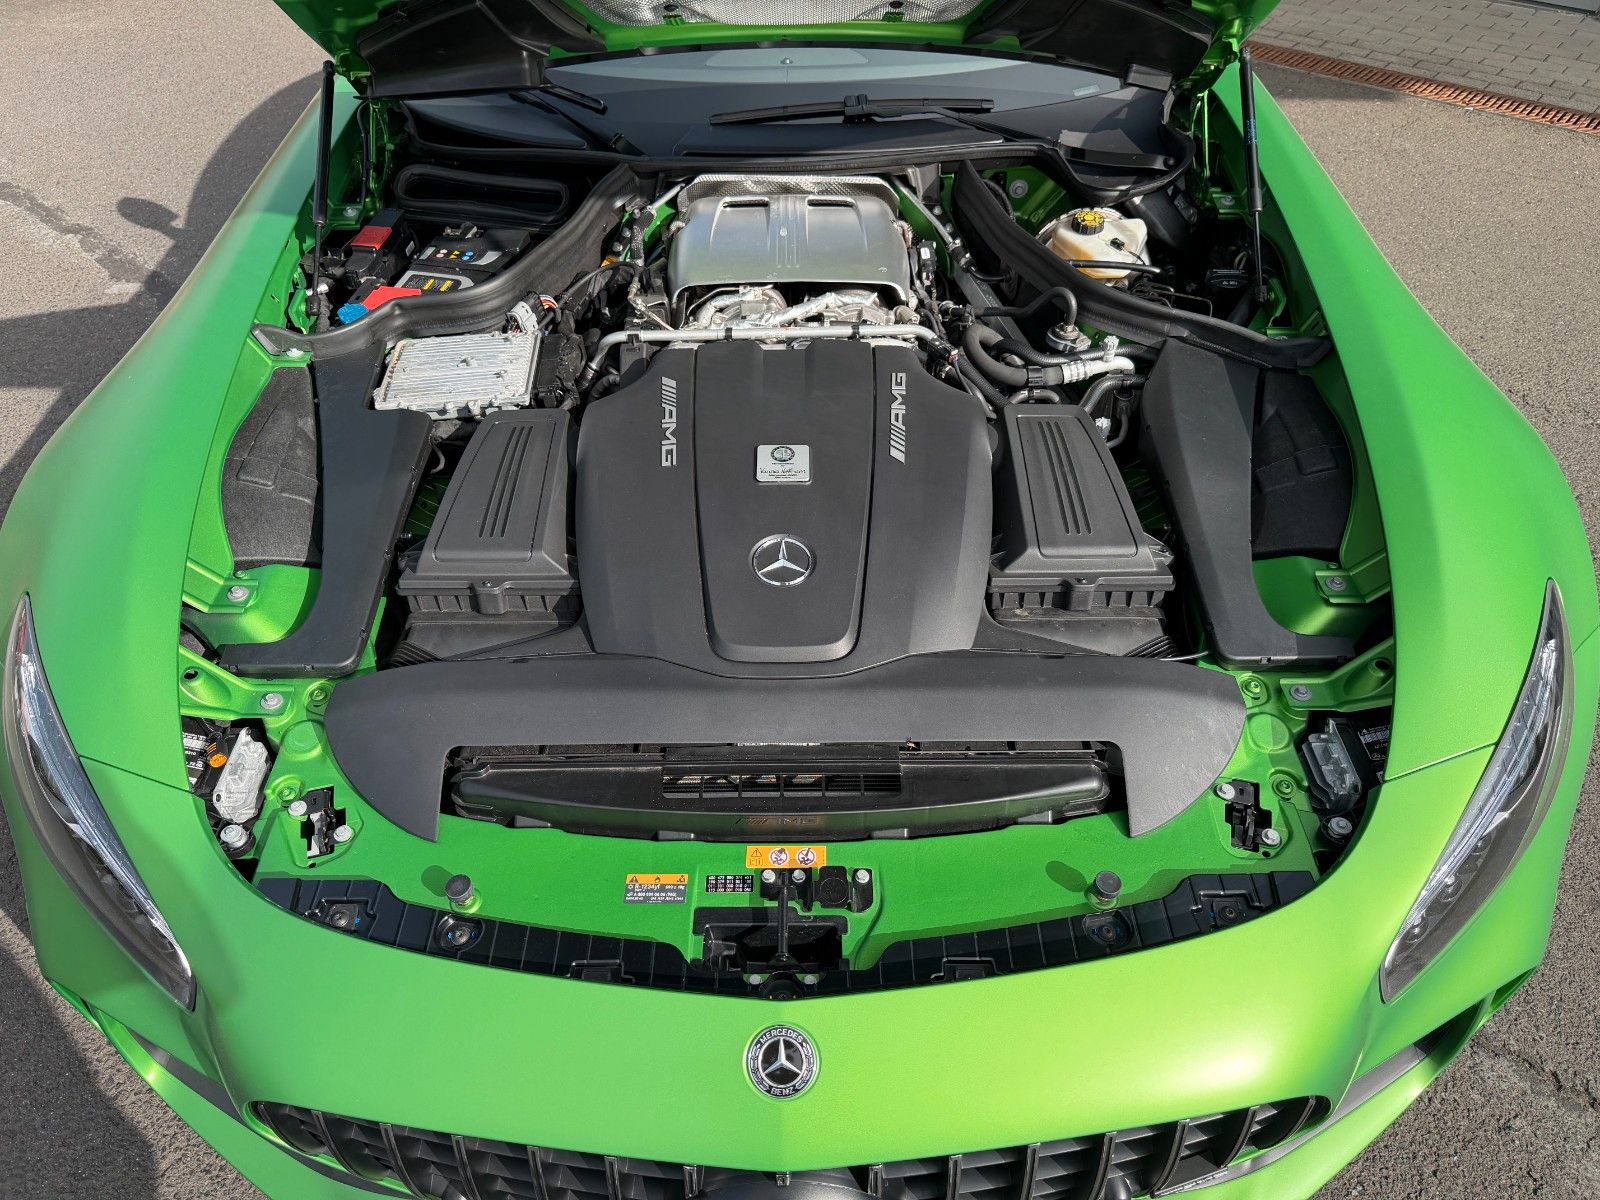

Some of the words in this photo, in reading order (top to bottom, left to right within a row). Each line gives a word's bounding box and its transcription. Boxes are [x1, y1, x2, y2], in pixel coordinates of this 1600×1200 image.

[890, 372, 907, 429] AMG
[661, 404, 677, 467] AMG
[759, 1028, 804, 1044] MERCEDES
[770, 1087, 796, 1096] BENZ
